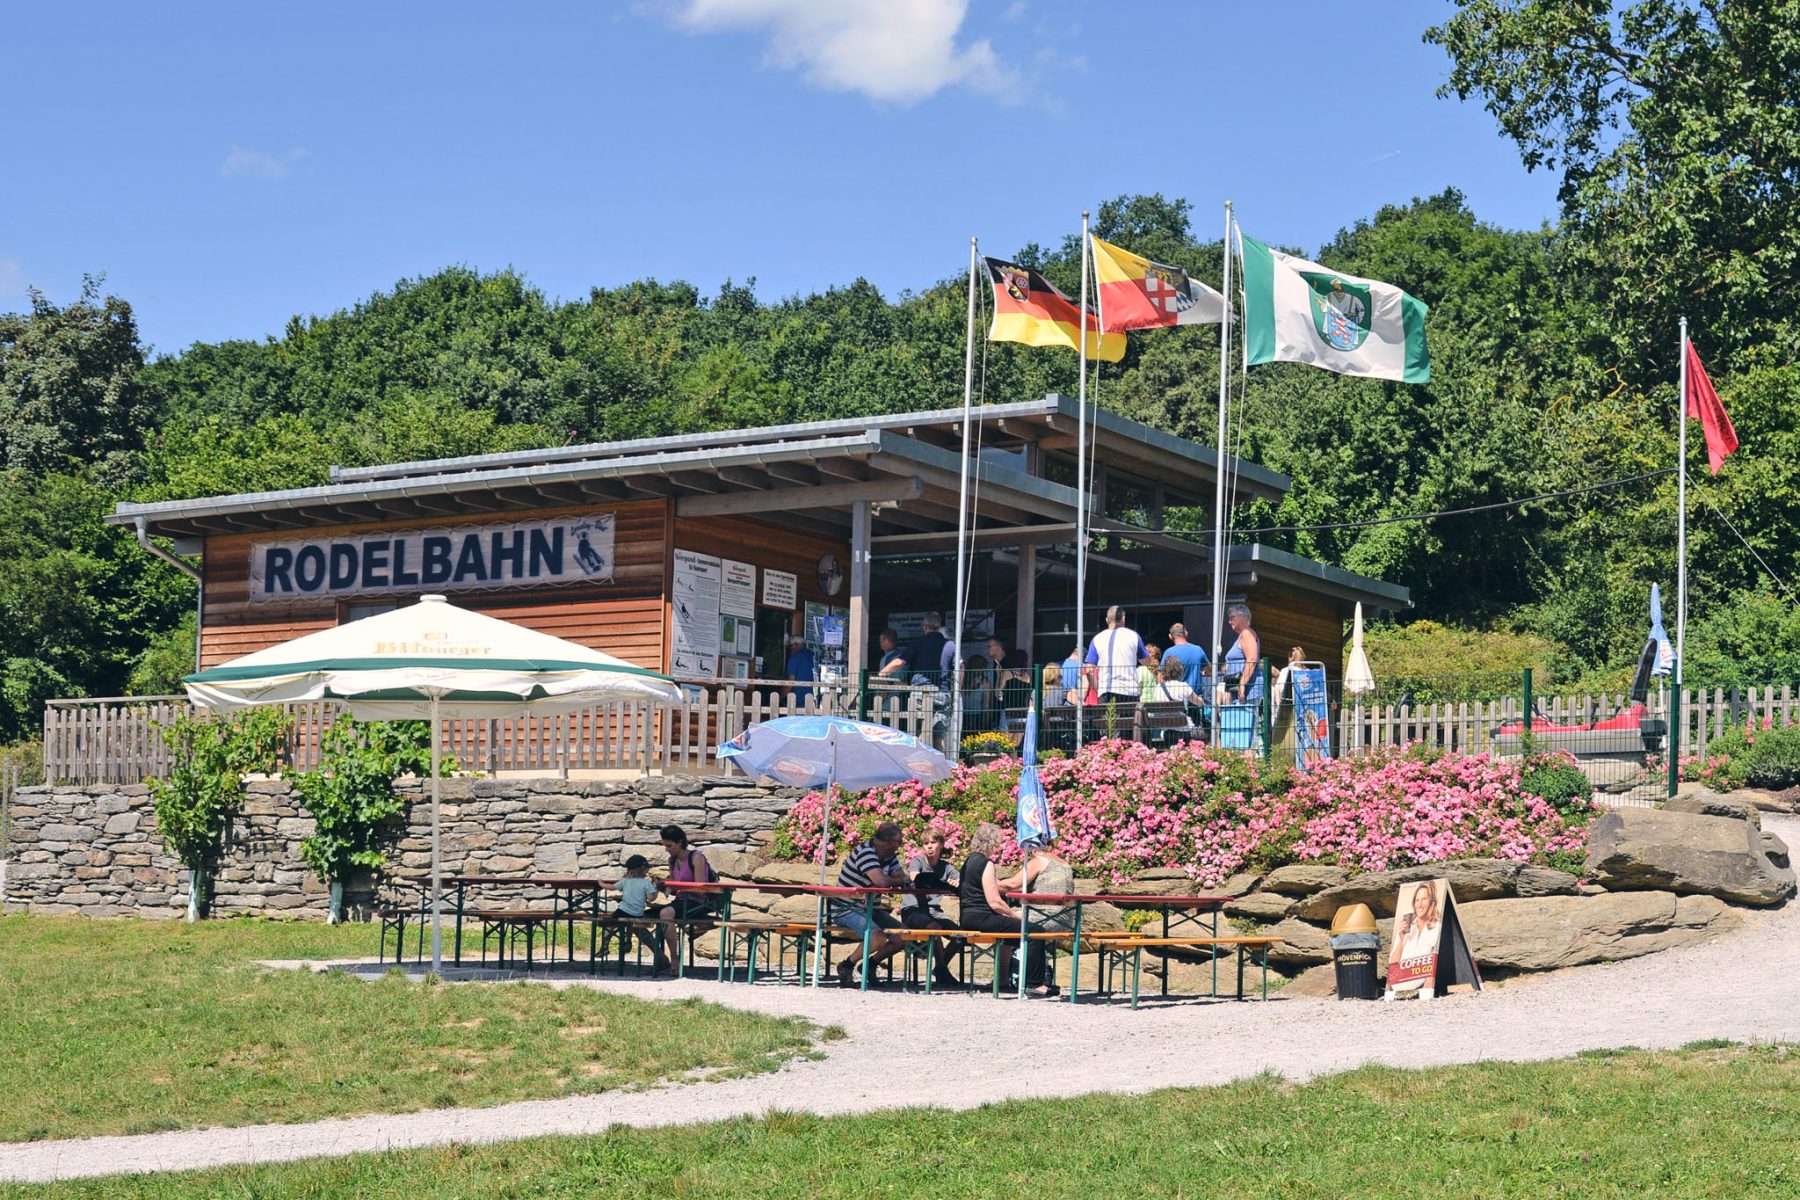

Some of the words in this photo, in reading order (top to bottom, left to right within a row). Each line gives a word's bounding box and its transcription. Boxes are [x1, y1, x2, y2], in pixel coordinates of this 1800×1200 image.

[264, 526, 564, 593] RODELBAHN
[373, 641, 492, 656] Bitburger
[1400, 955, 1433, 970] COFFEE
[1411, 967, 1421, 975] TO
[1422, 965, 1433, 973] GO
